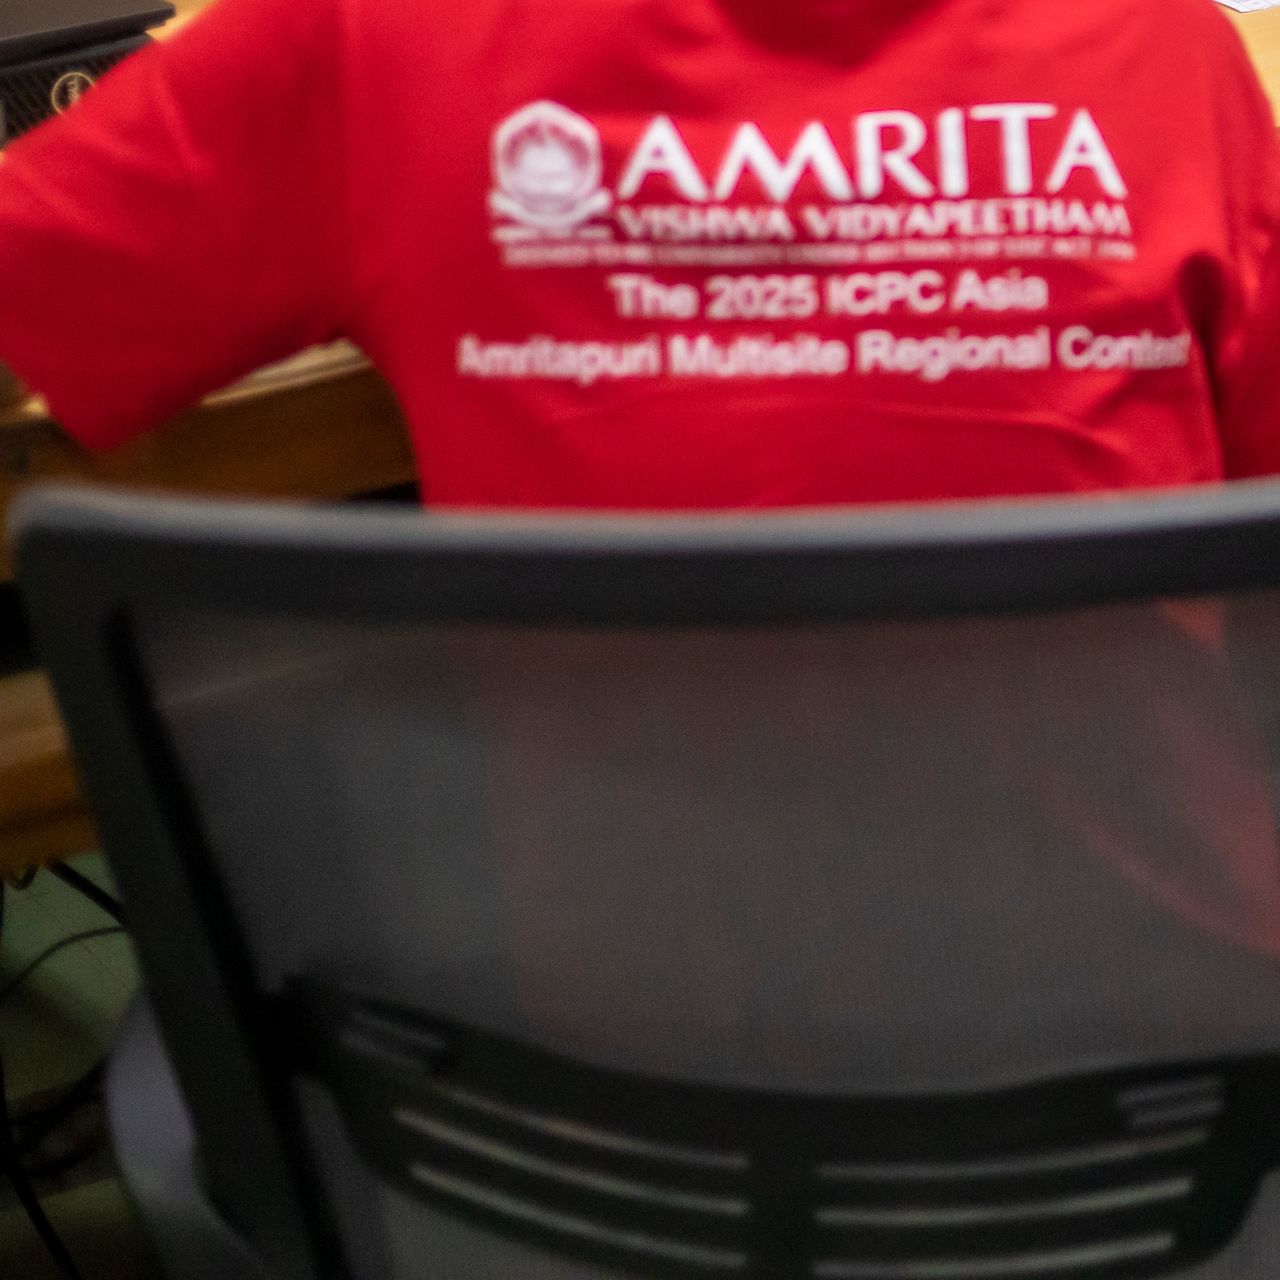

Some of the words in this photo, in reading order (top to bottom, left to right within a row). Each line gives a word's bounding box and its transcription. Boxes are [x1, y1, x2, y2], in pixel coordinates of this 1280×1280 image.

[617, 102, 1129, 201] AMRITA
[805, 198, 1131, 239] VIDYAPEETHAM
[608, 275, 697, 319] The
[709, 275, 815, 320] 2025
[828, 274, 944, 315] ICPC
[953, 270, 1048, 311] Asia
[458, 332, 660, 385] Amritapuri
[670, 333, 848, 377] Multisite
[857, 326, 1050, 381] Regional
